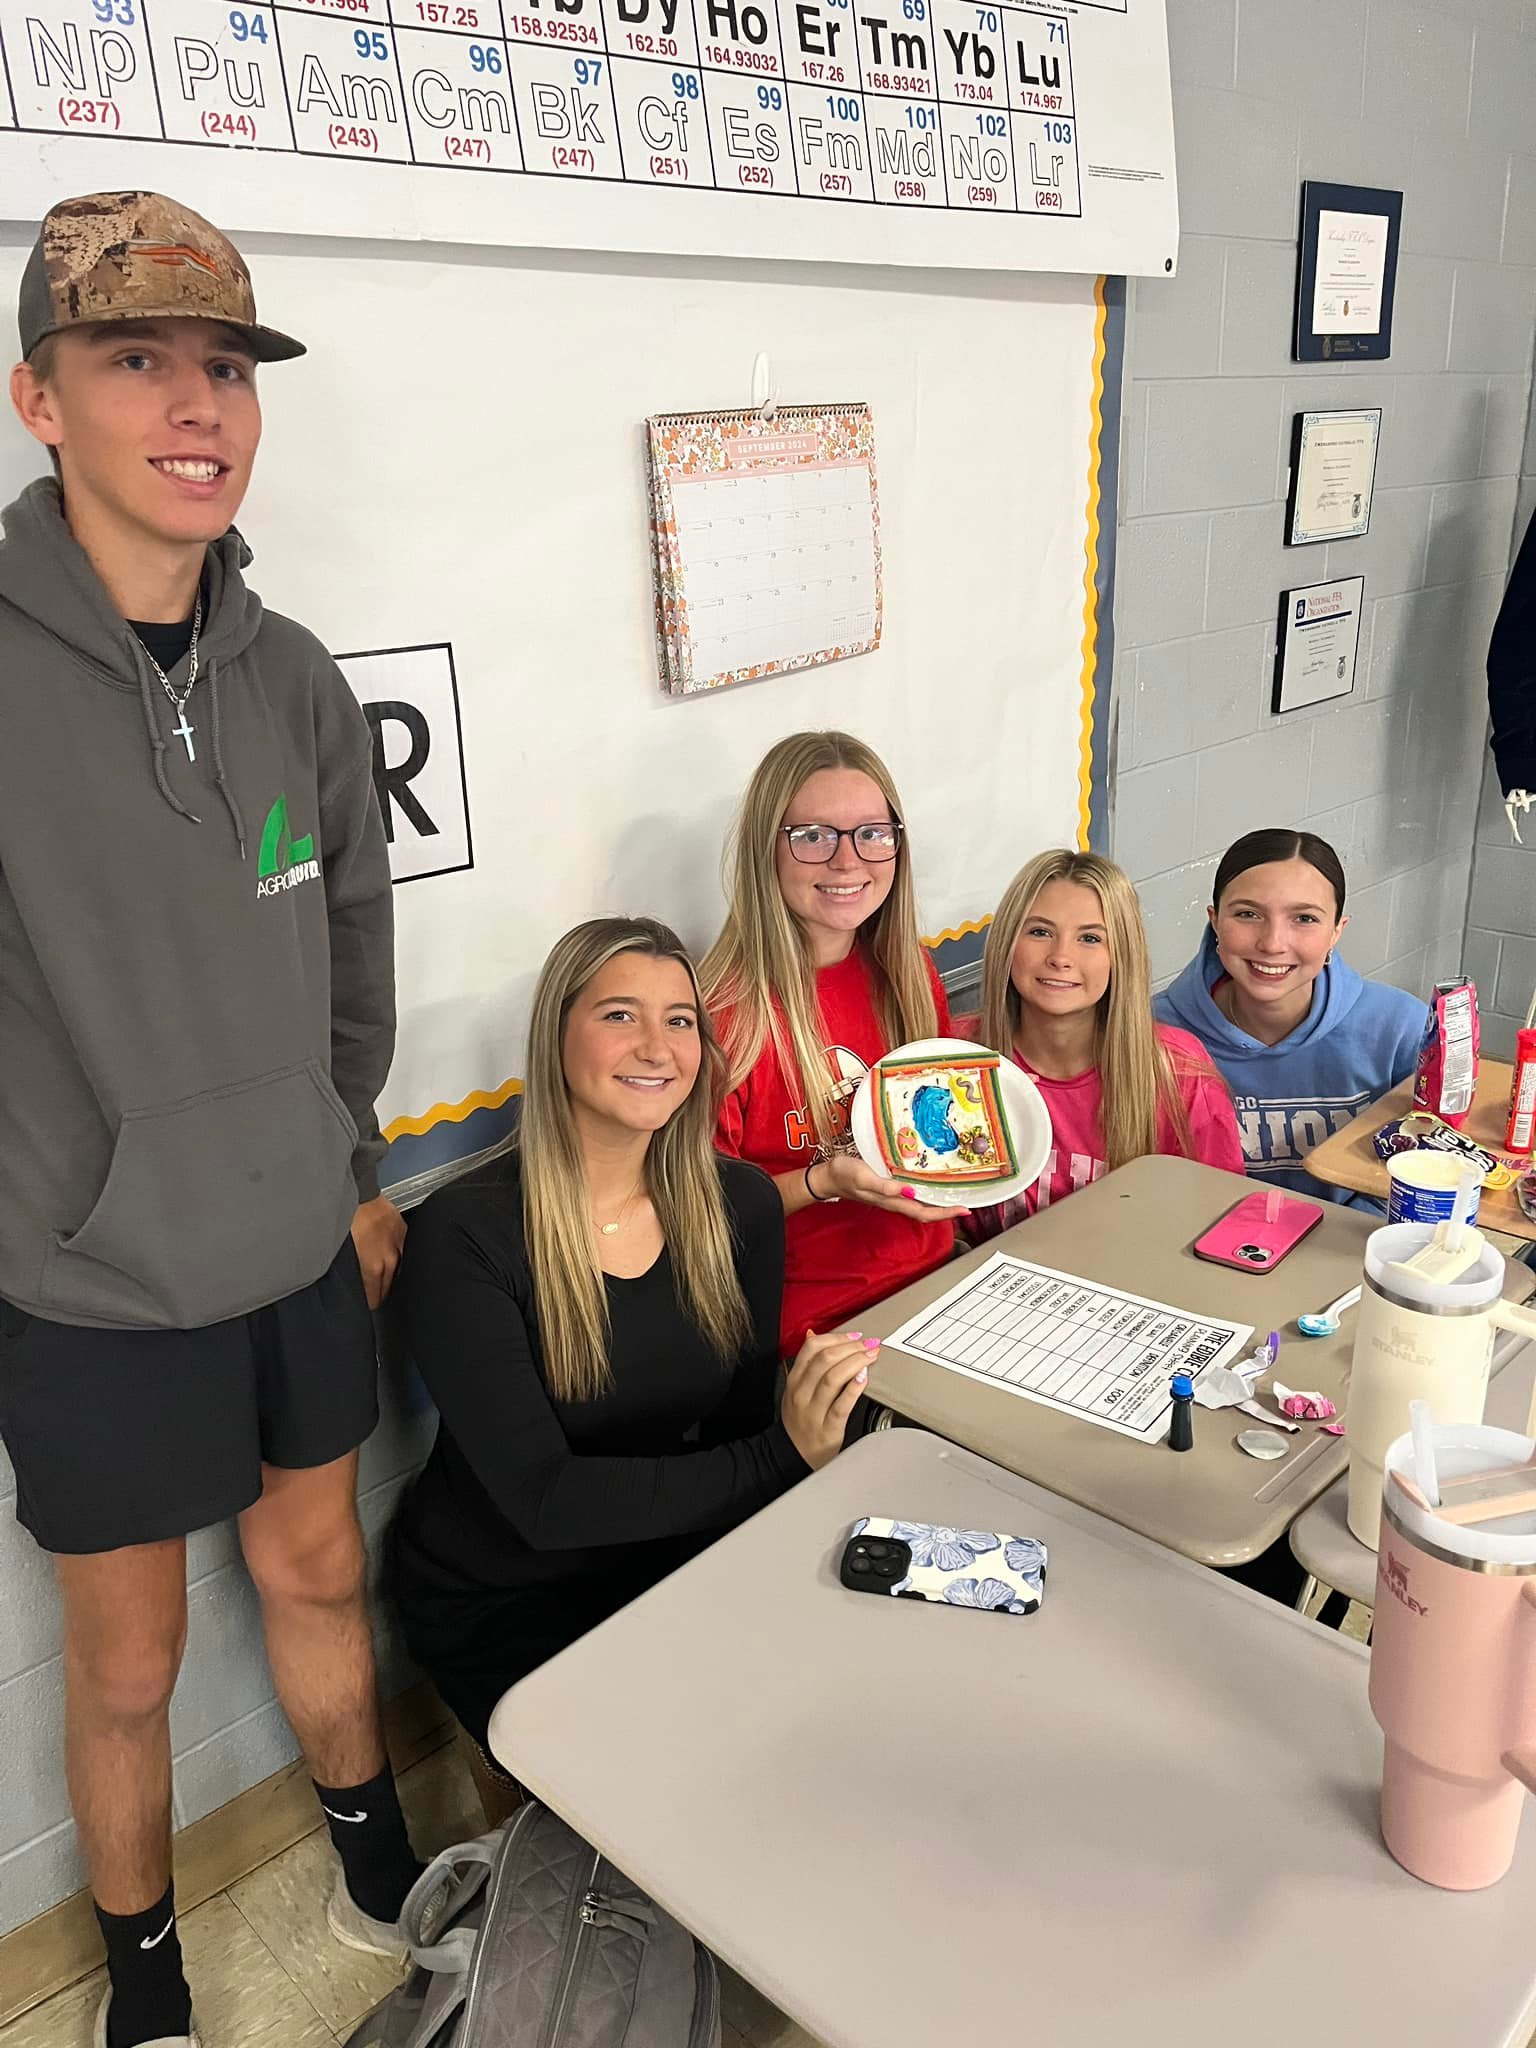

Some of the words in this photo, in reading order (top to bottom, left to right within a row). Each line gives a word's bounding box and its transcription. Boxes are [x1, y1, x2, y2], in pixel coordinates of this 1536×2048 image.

[92, 0, 135, 26] 93
[416, 2, 479, 28] 157.25
[707, 0, 768, 45] Ho
[902, 0, 926, 21] 69
[976, 9, 998, 33] 70
[229, 11, 268, 45] 94
[510, 15, 598, 45] 158.92534
[796, 4, 841, 57] Er
[1046, 21, 1066, 45] 71
[26, 17, 136, 98] Np
[353, 29, 388, 61] 95
[626, 32, 678, 57] 162.50
[861, 17, 928, 71] Tm
[943, 28, 996, 79] Yb
[469, 44, 502, 74] 96
[705, 45, 778, 72] 164.93032
[801, 61, 845, 83] 167.26
[1017, 40, 1061, 89] Lu
[174, 37, 266, 109] Pu
[574, 58, 602, 87] 97
[672, 72, 699, 99] 98
[865, 72, 932, 94] 168.93421
[297, 54, 397, 123] Am
[412, 69, 511, 134] Cm
[757, 85, 782, 111] 99
[953, 82, 993, 101] 173.04
[1019, 90, 1063, 110] 174.967
[58, 97, 120, 130] (237)
[531, 82, 605, 143] Bk
[826, 95, 860, 122] 100
[905, 105, 936, 130] 101
[200, 110, 257, 142] (244)
[638, 96, 688, 152] Cf
[723, 107, 780, 162] Es
[975, 113, 1007, 138] 102
[1043, 121, 1072, 144] 103
[328, 124, 378, 153] (243)
[444, 136, 491, 163] (247)
[799, 117, 863, 170] Fm
[875, 127, 936, 177] Md
[552, 146, 595, 172] (247)
[650, 155, 689, 181] (251)
[950, 134, 1008, 183] No
[1029, 142, 1064, 187] Lr
[738, 165, 774, 188] (252)
[819, 172, 852, 195] (257)
[894, 180, 926, 200] (258)
[967, 185, 997, 205] (259)
[1035, 191, 1062, 210] (262)
[737, 441, 784, 453] SEPTEMBER
[362, 701, 440, 843] R
[1203, 1329, 1229, 1345] THE
[1182, 1343, 1217, 1369] EDIBLE
[1102, 1387, 1125, 1405] FOOD
